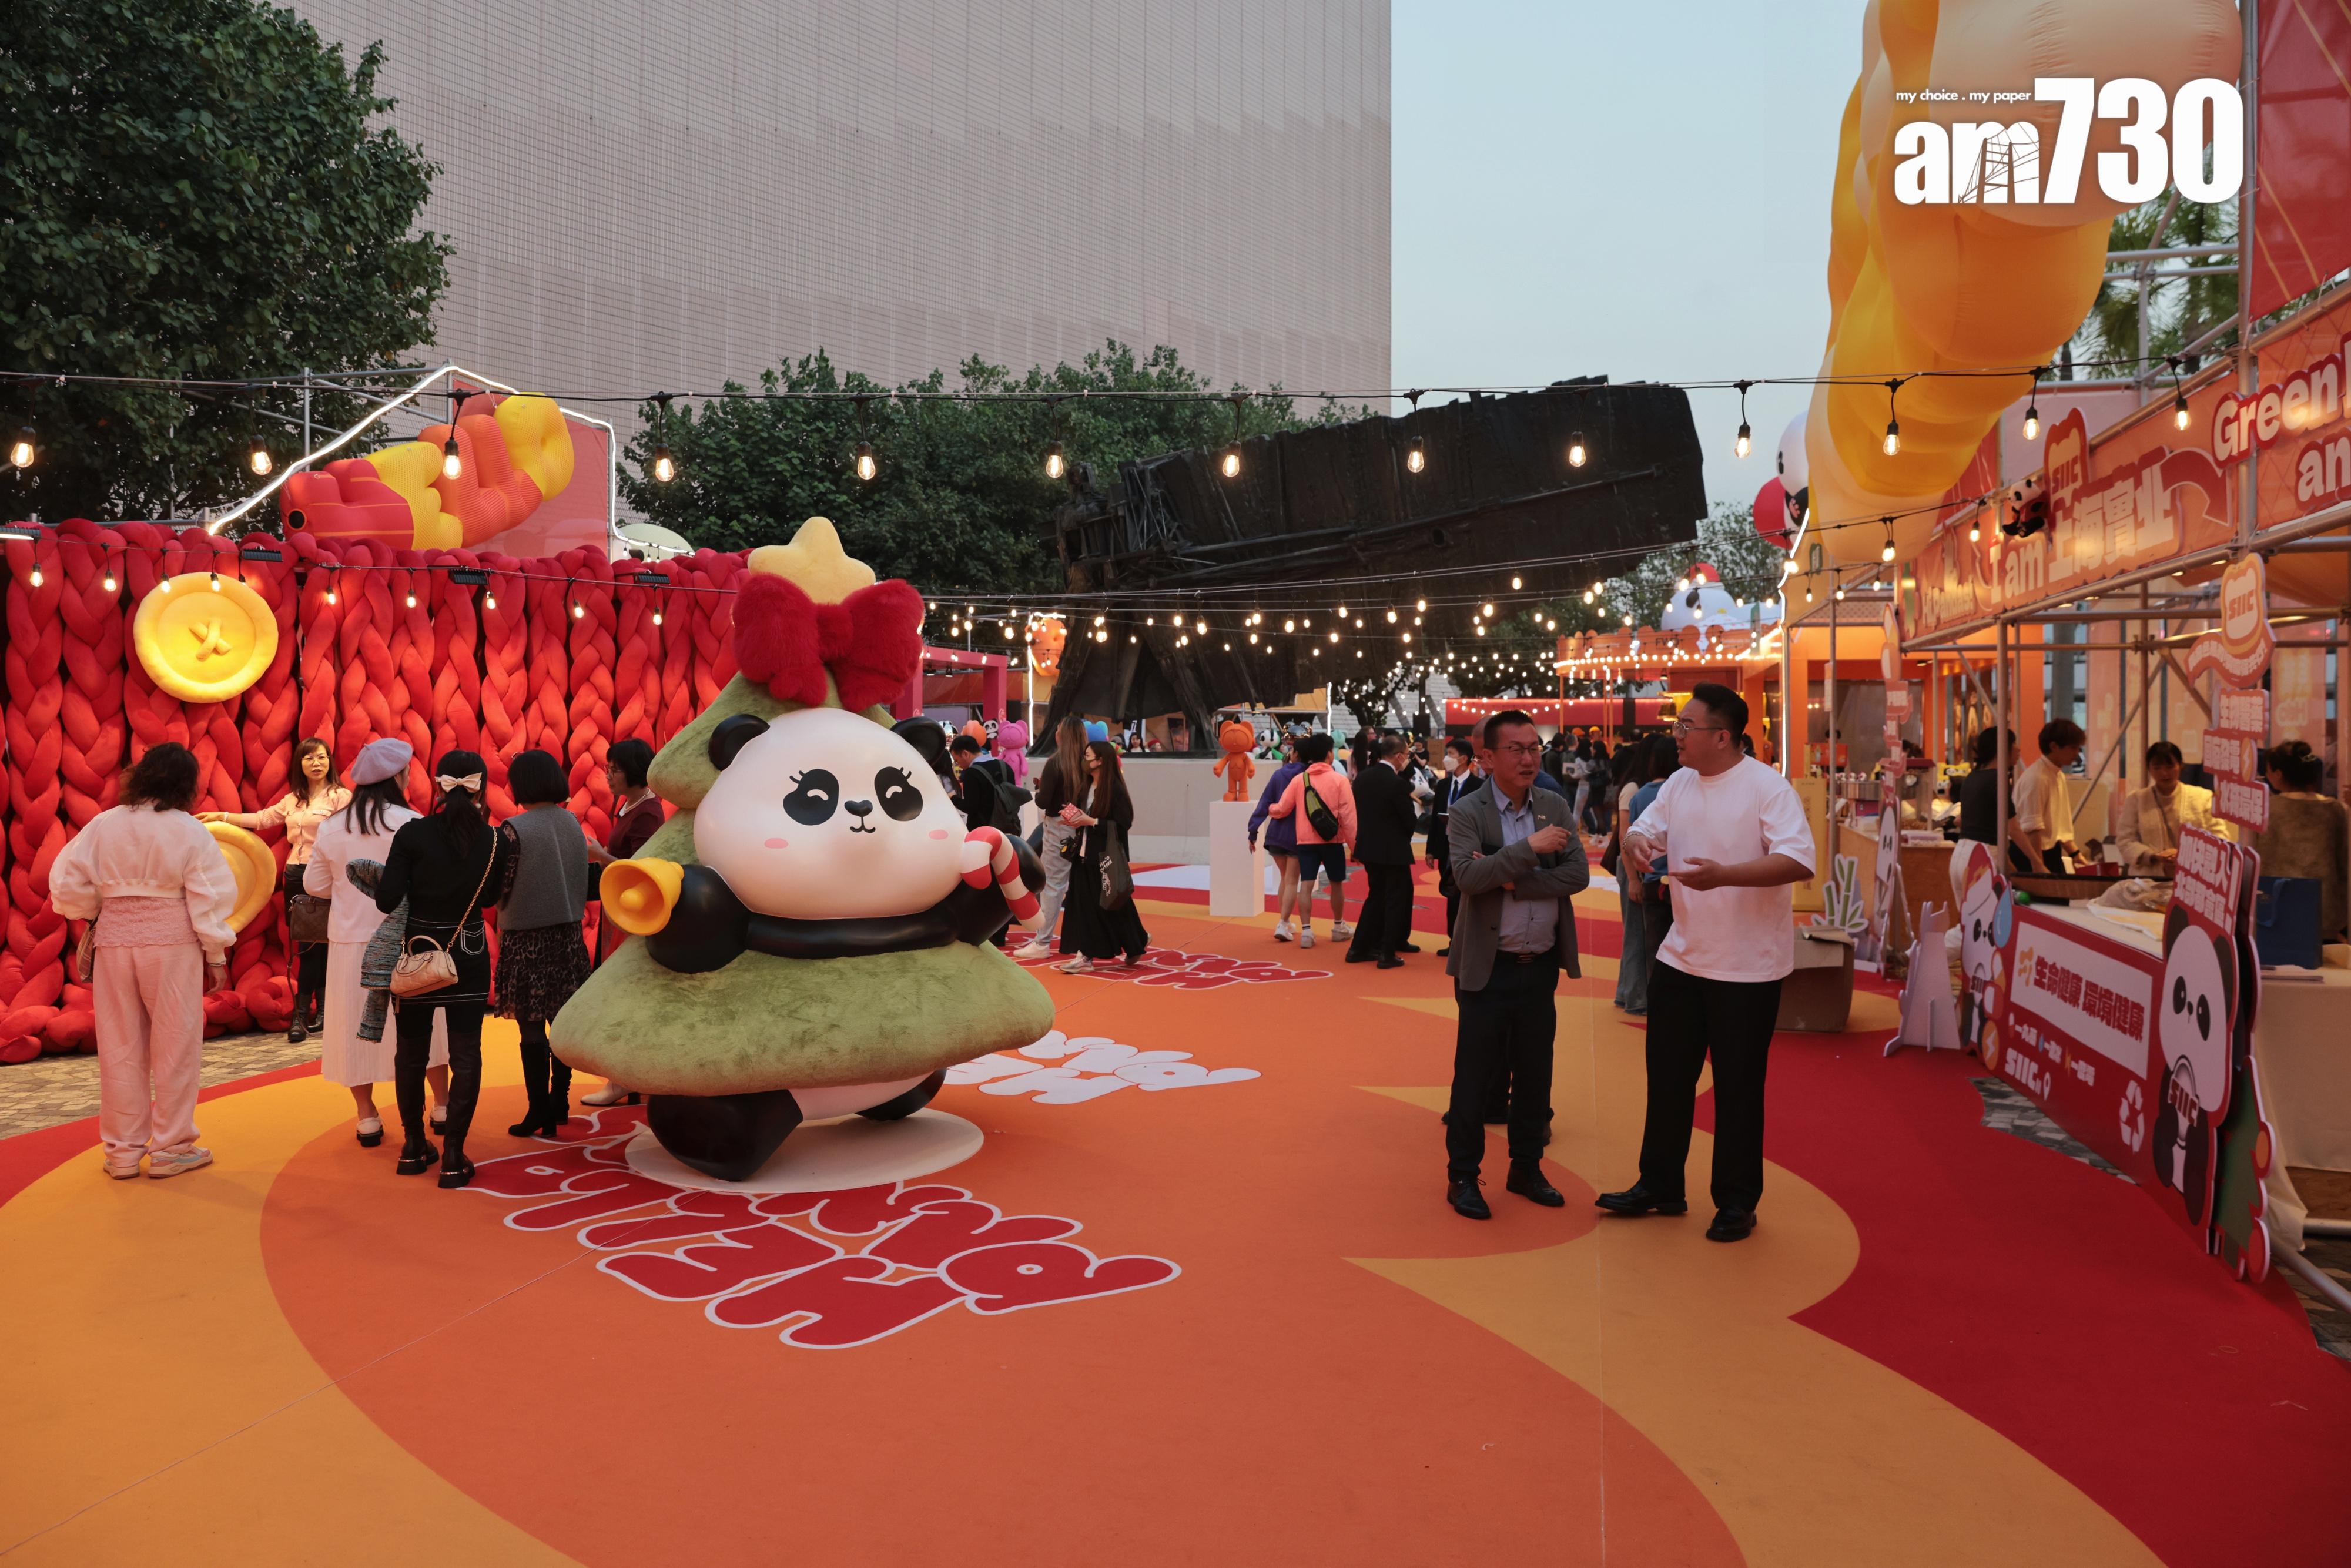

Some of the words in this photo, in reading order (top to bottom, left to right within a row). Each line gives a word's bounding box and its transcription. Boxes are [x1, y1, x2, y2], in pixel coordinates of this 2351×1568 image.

[2052, 455, 2079, 495] SIIC
[1990, 544, 2001, 604] I
[2005, 540, 2044, 599] am
[2228, 589, 2254, 621] SIIC
[1971, 975, 1984, 993] SII
[2005, 1047, 2038, 1091] SIIC
[2169, 1078, 2198, 1124] SIIC
